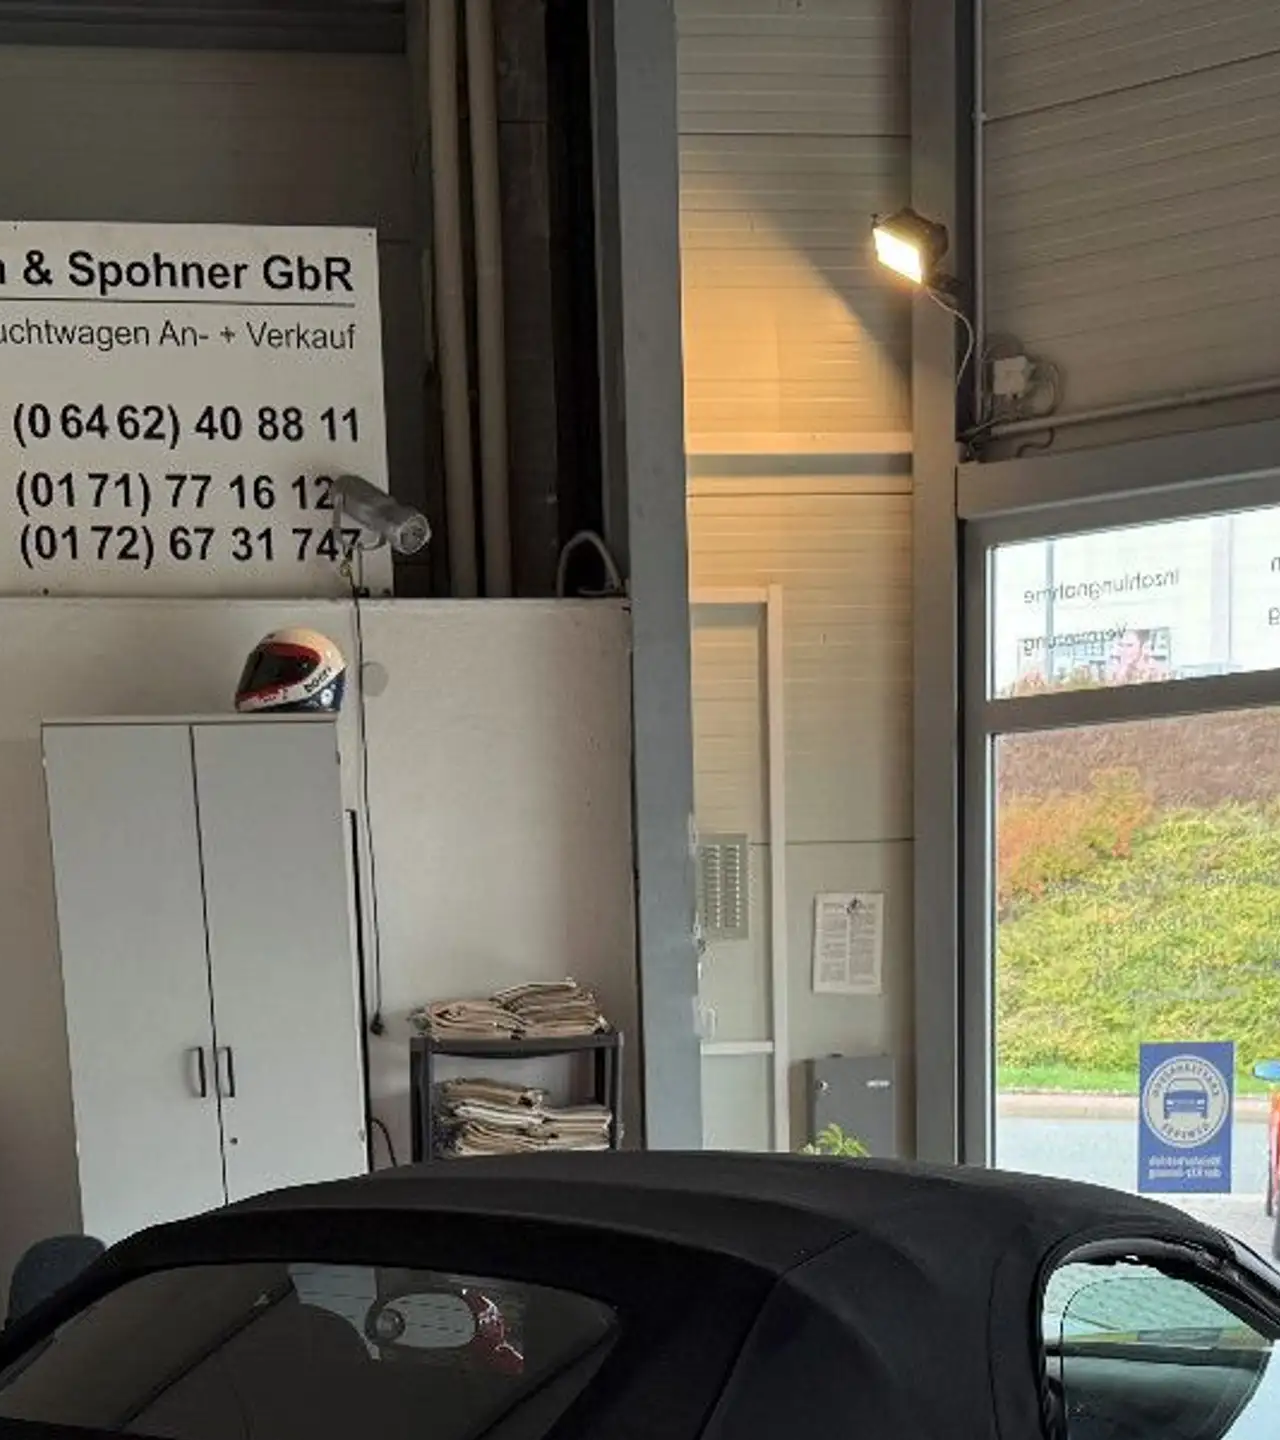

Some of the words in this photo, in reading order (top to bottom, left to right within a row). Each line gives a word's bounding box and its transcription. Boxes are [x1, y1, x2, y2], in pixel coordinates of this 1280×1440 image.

[23, 249, 53, 286] &
[68, 250, 248, 296] Spohner
[262, 254, 354, 292] GbR
[159, 319, 209, 347] An-
[220, 326, 236, 343] +
[246, 319, 356, 350] Verkauf
[195, 405, 242, 440] 40
[258, 406, 303, 441] 88
[320, 406, 358, 442] 11
[165, 474, 212, 508] 77
[229, 474, 275, 510] 16
[169, 525, 215, 561] 67
[231, 526, 273, 561] 31
